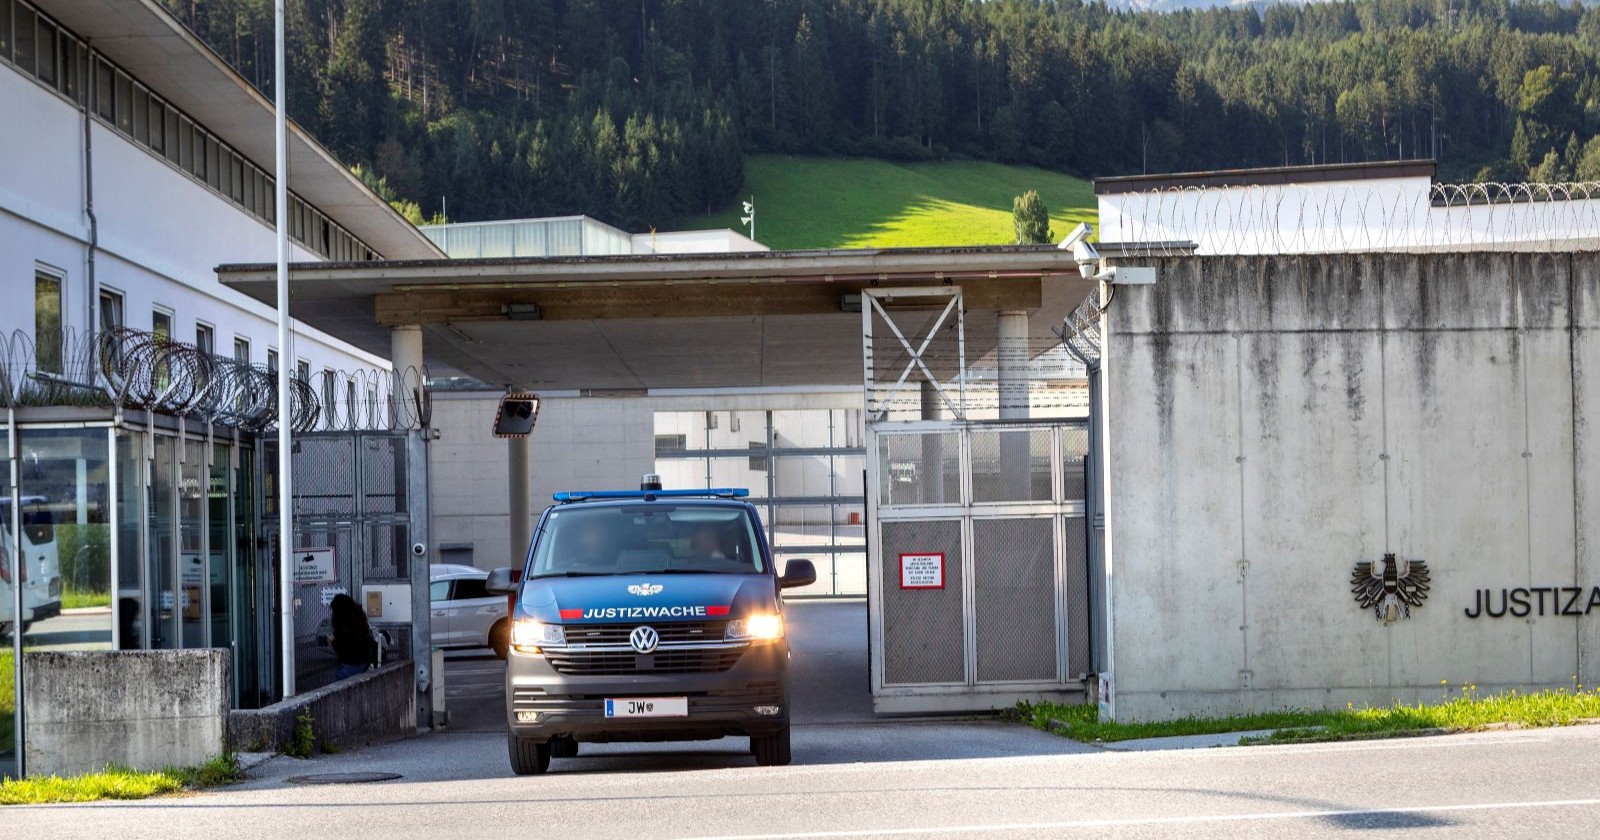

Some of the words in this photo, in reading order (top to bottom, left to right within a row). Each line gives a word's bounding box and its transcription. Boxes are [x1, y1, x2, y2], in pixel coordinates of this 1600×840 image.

[1464, 586, 1600, 618] JUSTIZA
[584, 606, 706, 618] JUSTIZWACHE
[631, 627, 658, 652] VW
[628, 701, 646, 714] JW
